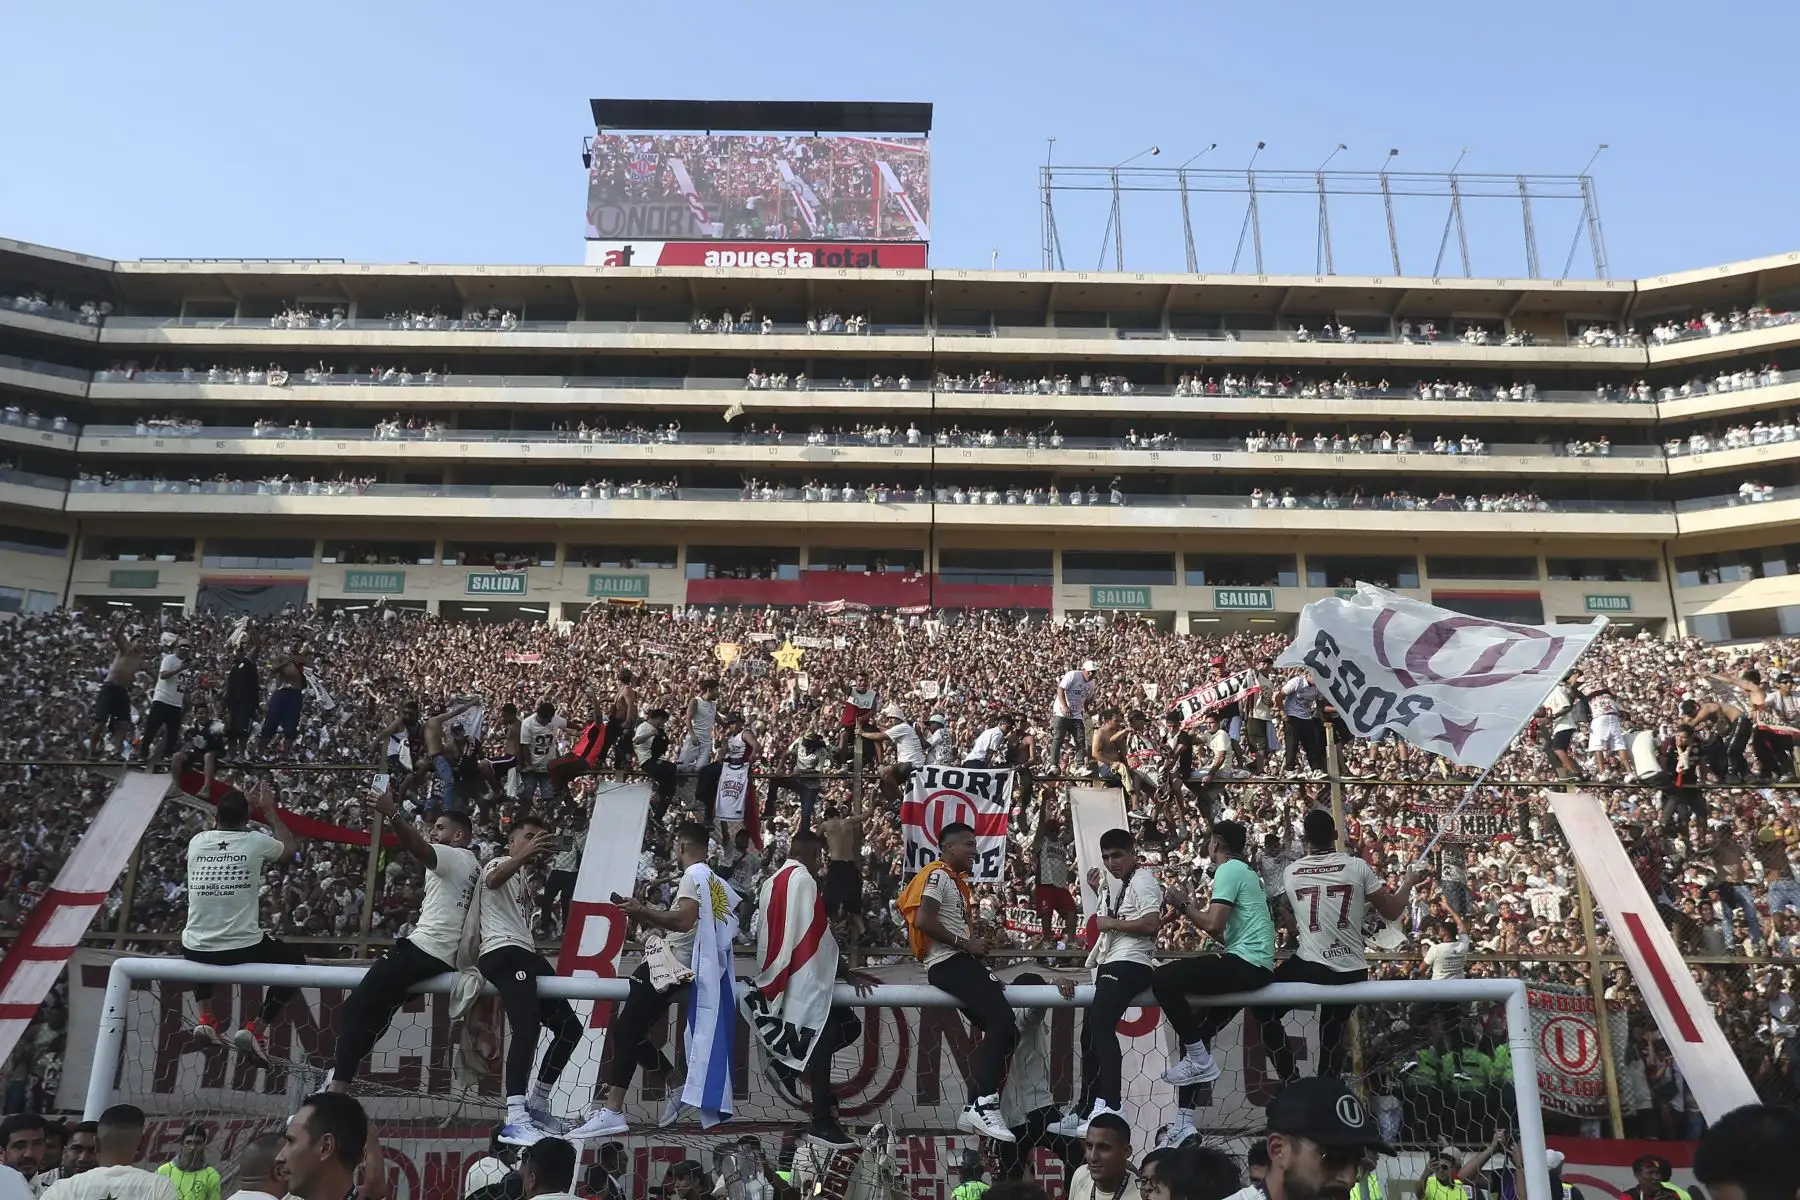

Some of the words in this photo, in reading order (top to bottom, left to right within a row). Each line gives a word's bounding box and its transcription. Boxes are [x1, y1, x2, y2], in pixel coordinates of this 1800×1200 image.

[350, 575, 397, 588] SALIDA
[472, 577, 520, 590] SALIDA
[594, 579, 642, 592] SALIDA
[1097, 590, 1144, 603] SALIDA
[1219, 592, 1267, 606] SALIDA
[1588, 596, 1628, 608] SALIDA
[781, 653, 795, 663] 27
[196, 853, 247, 863] marathon
[1300, 867, 1339, 875] JETOUR
[1294, 884, 1355, 934] 77
[1322, 947, 1354, 960] CRISTAL
[1340, 1099, 1362, 1125] U
